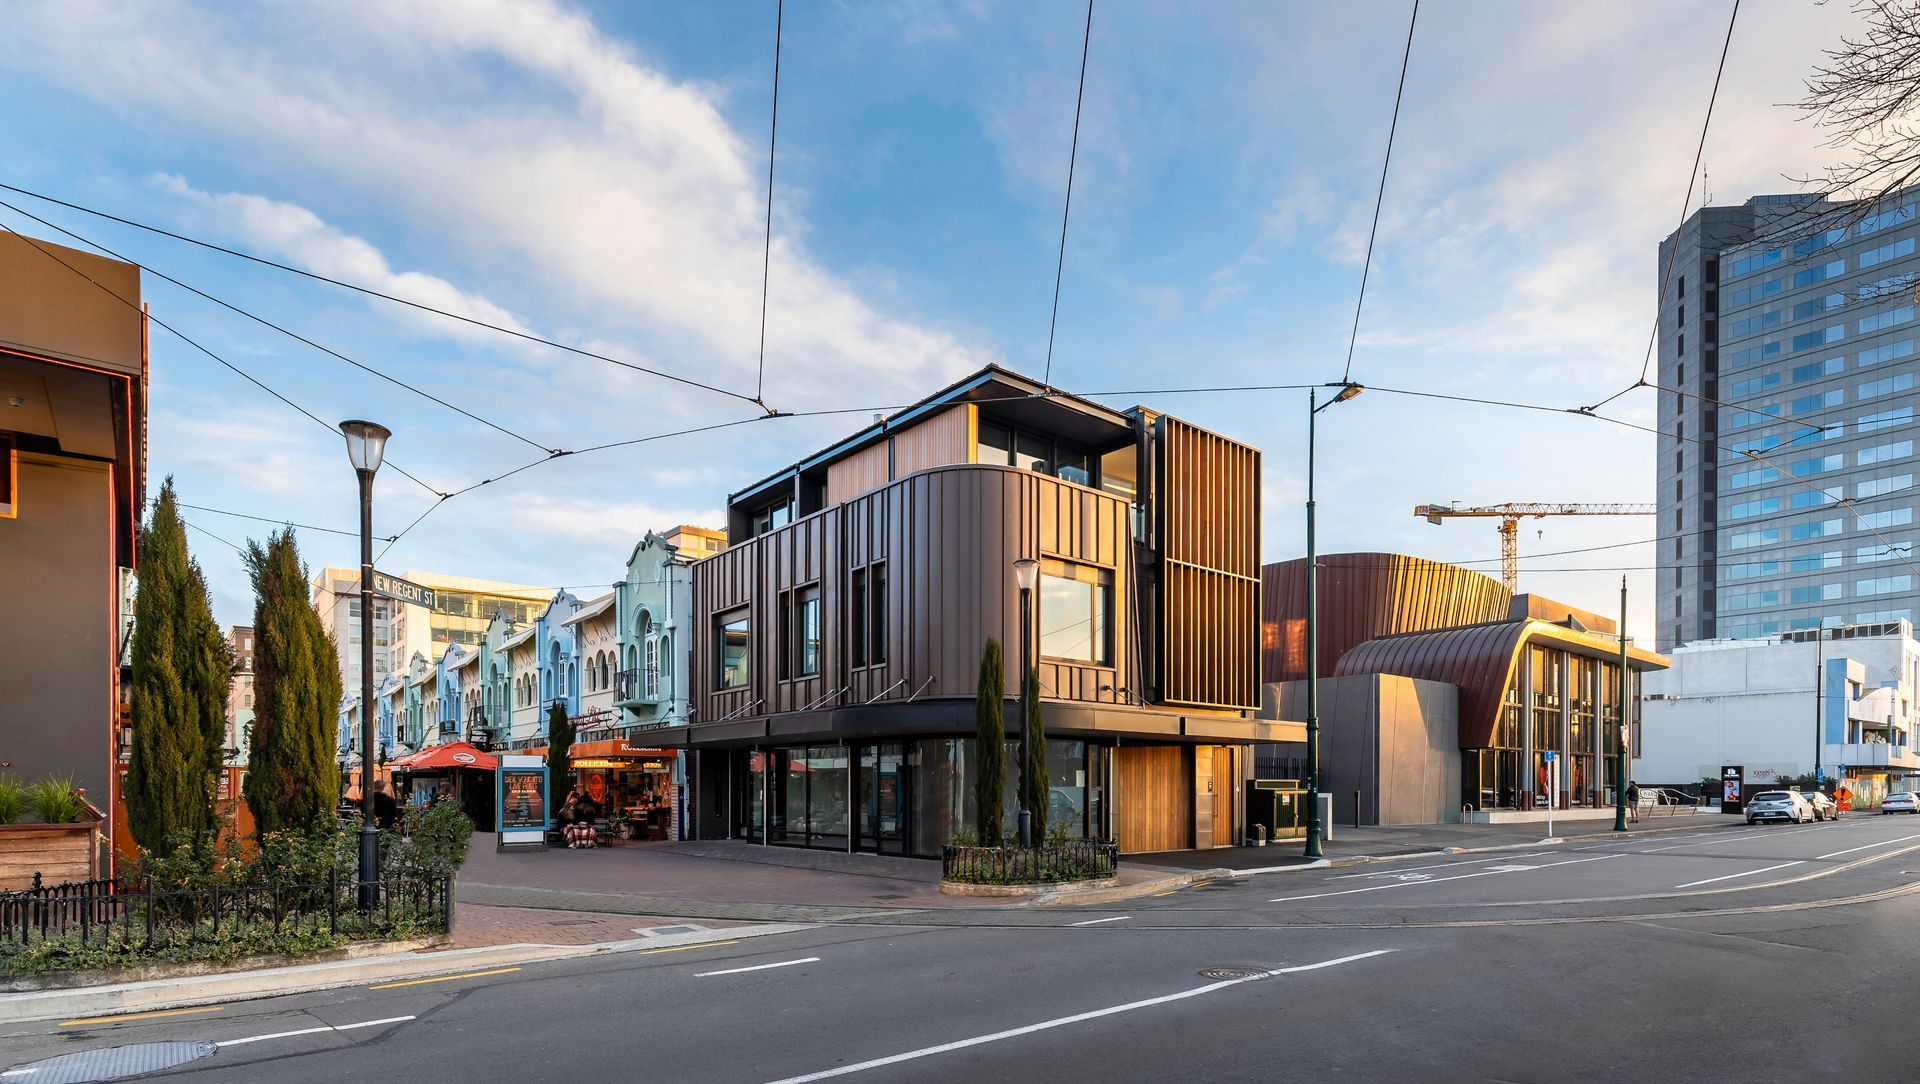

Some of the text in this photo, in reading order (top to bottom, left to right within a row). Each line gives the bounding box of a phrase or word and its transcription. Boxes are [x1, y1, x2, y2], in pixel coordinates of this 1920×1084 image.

[374, 575, 434, 605] NEW REGENT ST
